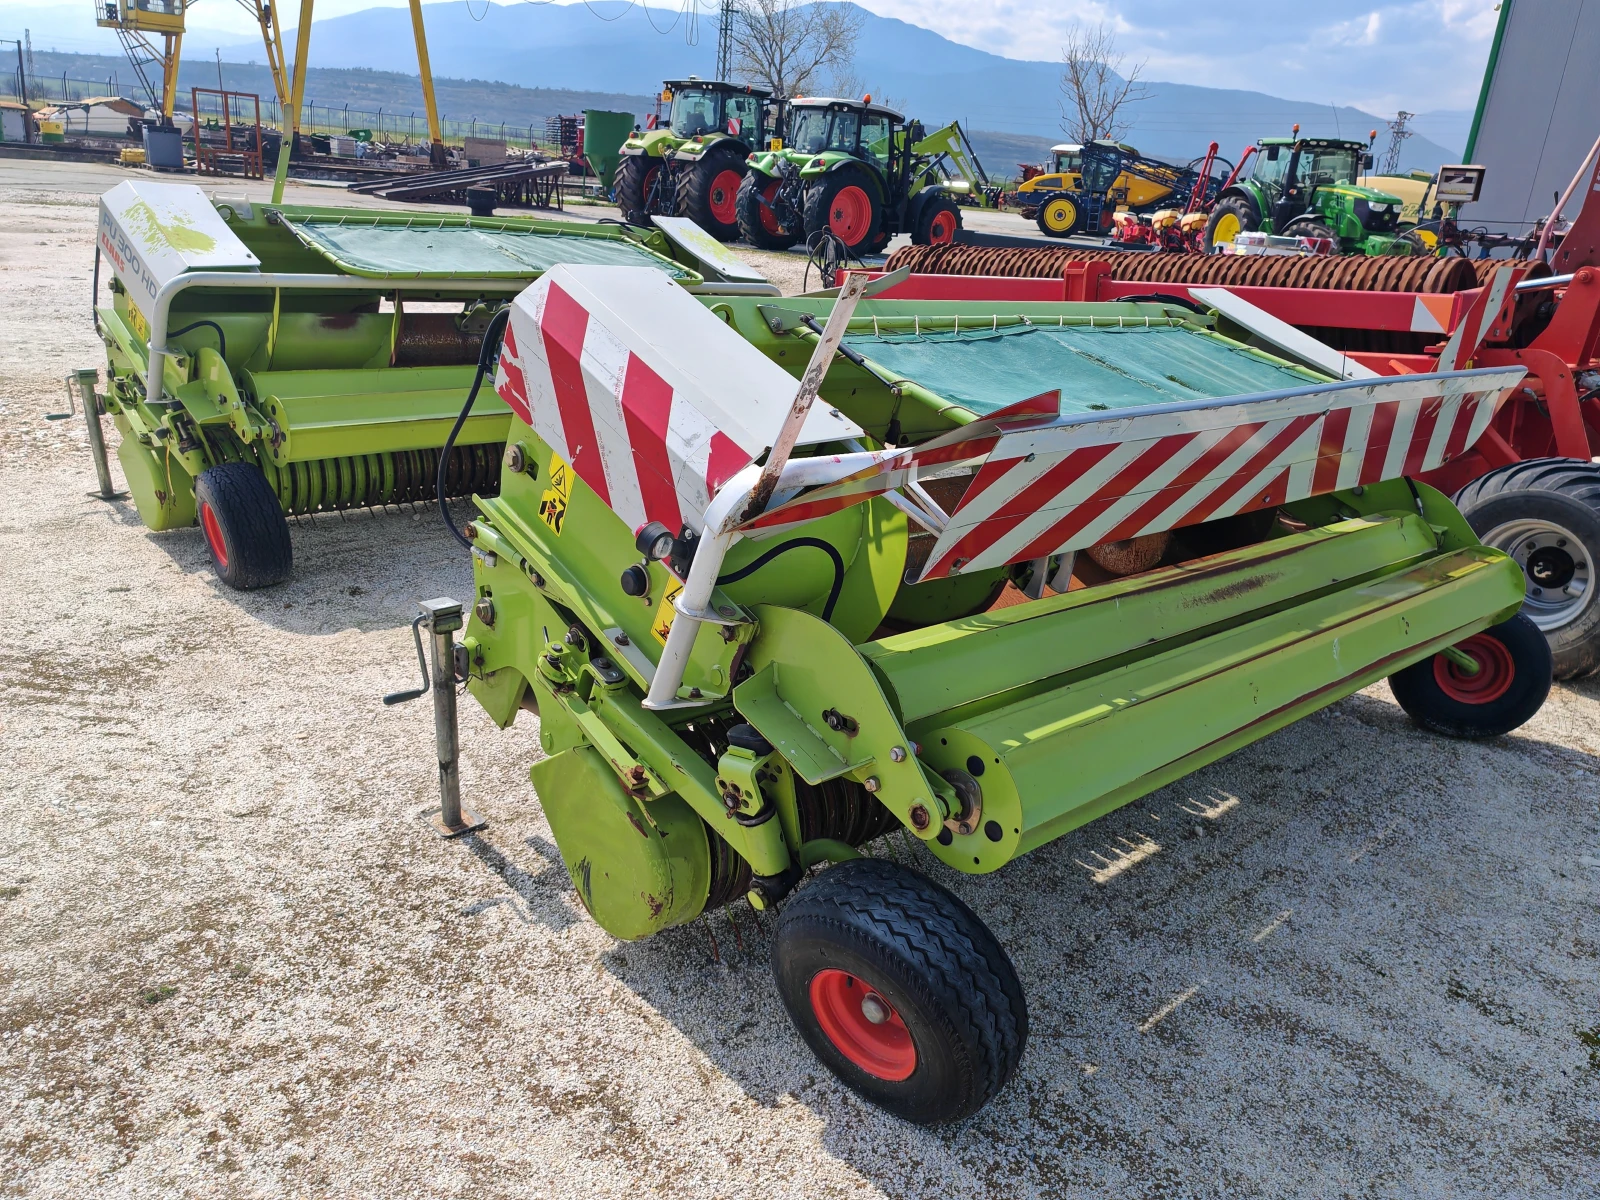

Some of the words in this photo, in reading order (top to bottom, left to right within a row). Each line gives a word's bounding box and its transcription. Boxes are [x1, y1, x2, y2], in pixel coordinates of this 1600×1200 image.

[103, 212, 117, 239] PU
[117, 233, 140, 275] 300
[141, 268, 158, 300] HD
